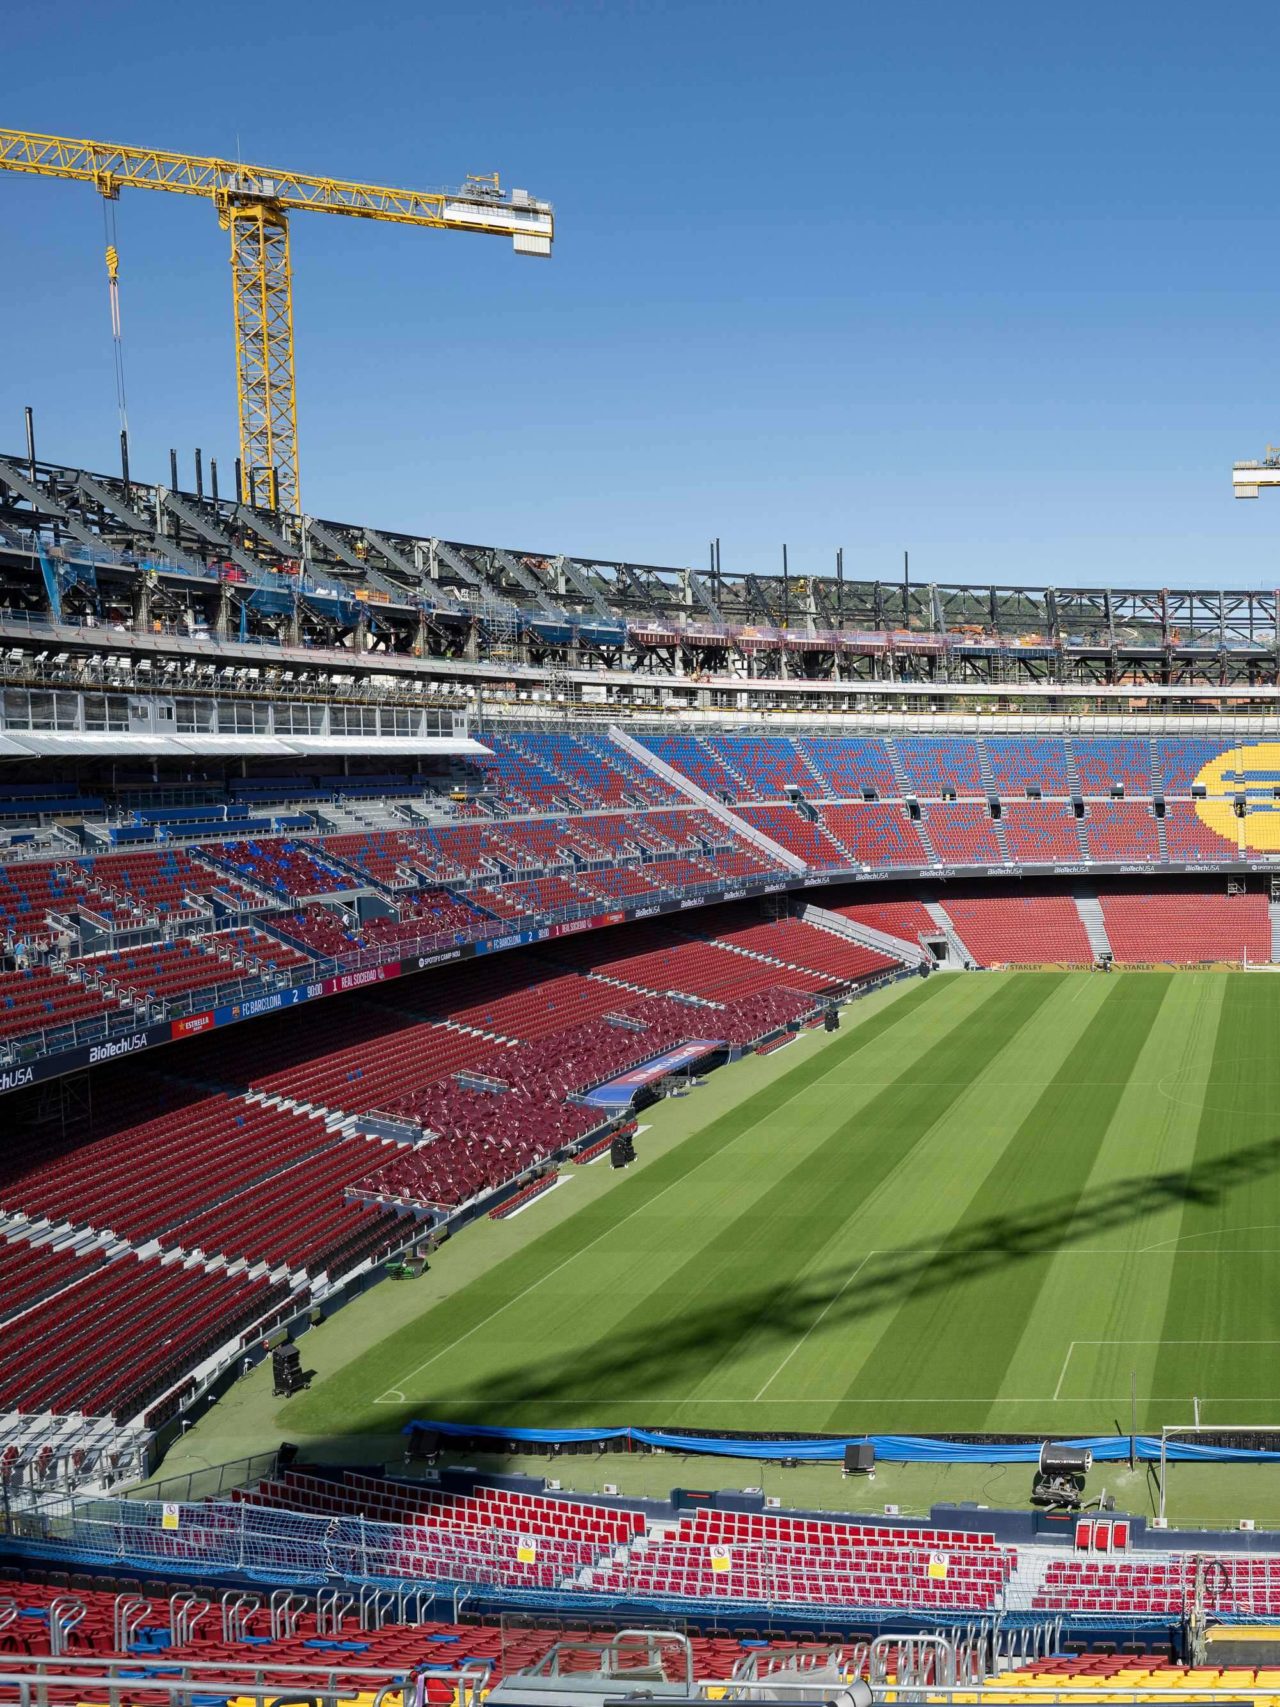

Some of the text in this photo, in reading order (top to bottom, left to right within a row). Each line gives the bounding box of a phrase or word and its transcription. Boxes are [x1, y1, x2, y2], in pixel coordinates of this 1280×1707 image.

[919, 869, 955, 877] BioTechUSA
[987, 867, 1022, 875] BioTechUSA
[1185, 864, 1220, 872] BioTechUSA
[856, 872, 889, 880] BioTechUSA
[528, 932, 533, 942] 2
[556, 926, 559, 936] 1
[242, 970, 376, 1016] FC BARCELONA 2 90:00 1 REAL SOCIEDAD
[185, 1017, 209, 1030] ESTRELLA
[90, 1034, 147, 1062] BioTechUSA
